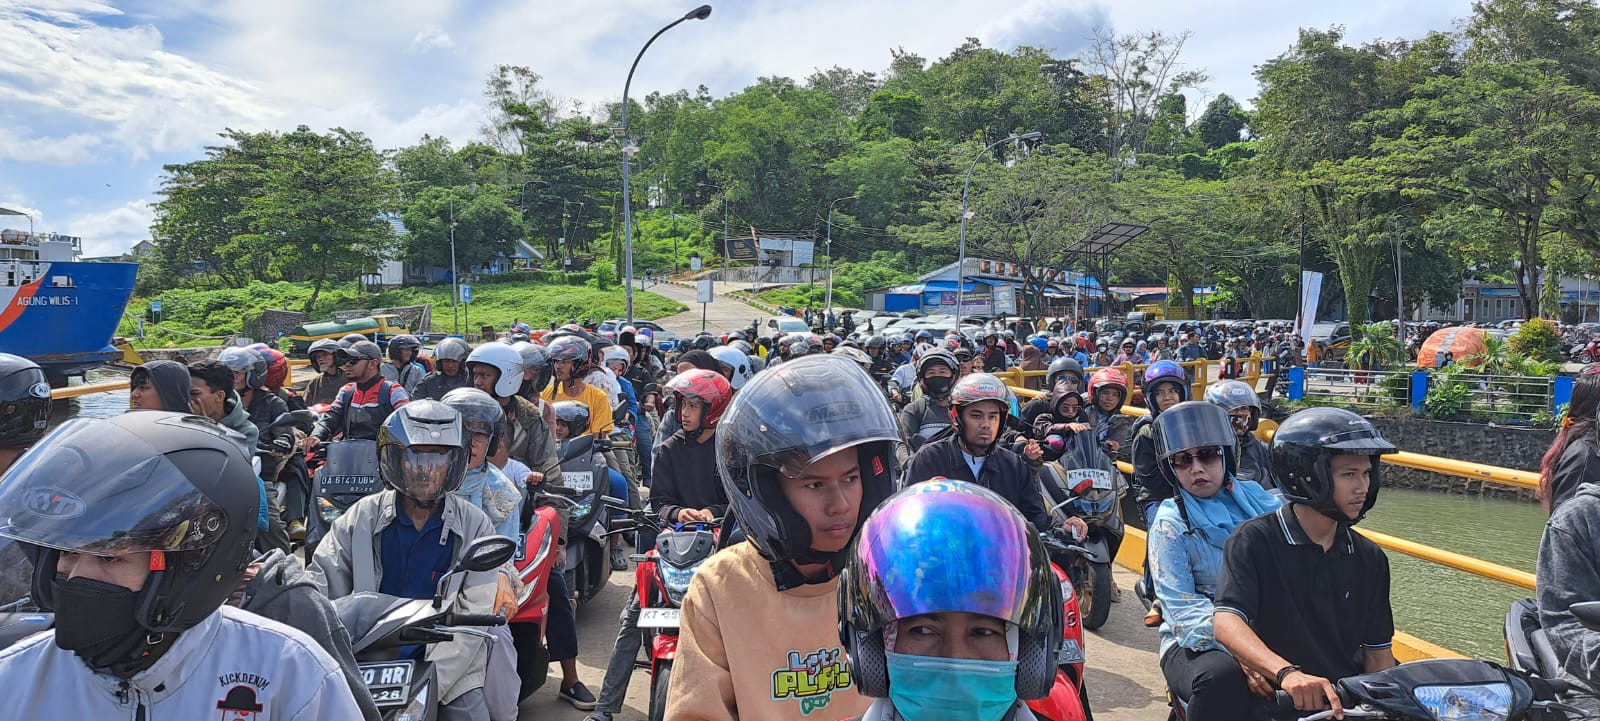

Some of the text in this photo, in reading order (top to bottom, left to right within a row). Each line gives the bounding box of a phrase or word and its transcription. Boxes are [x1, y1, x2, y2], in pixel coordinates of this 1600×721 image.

[17, 296, 48, 306] AGUNG
[643, 610, 658, 620] KT
[788, 649, 839, 674] Lets
[380, 666, 405, 684] HR
[774, 662, 851, 698] PLAY
